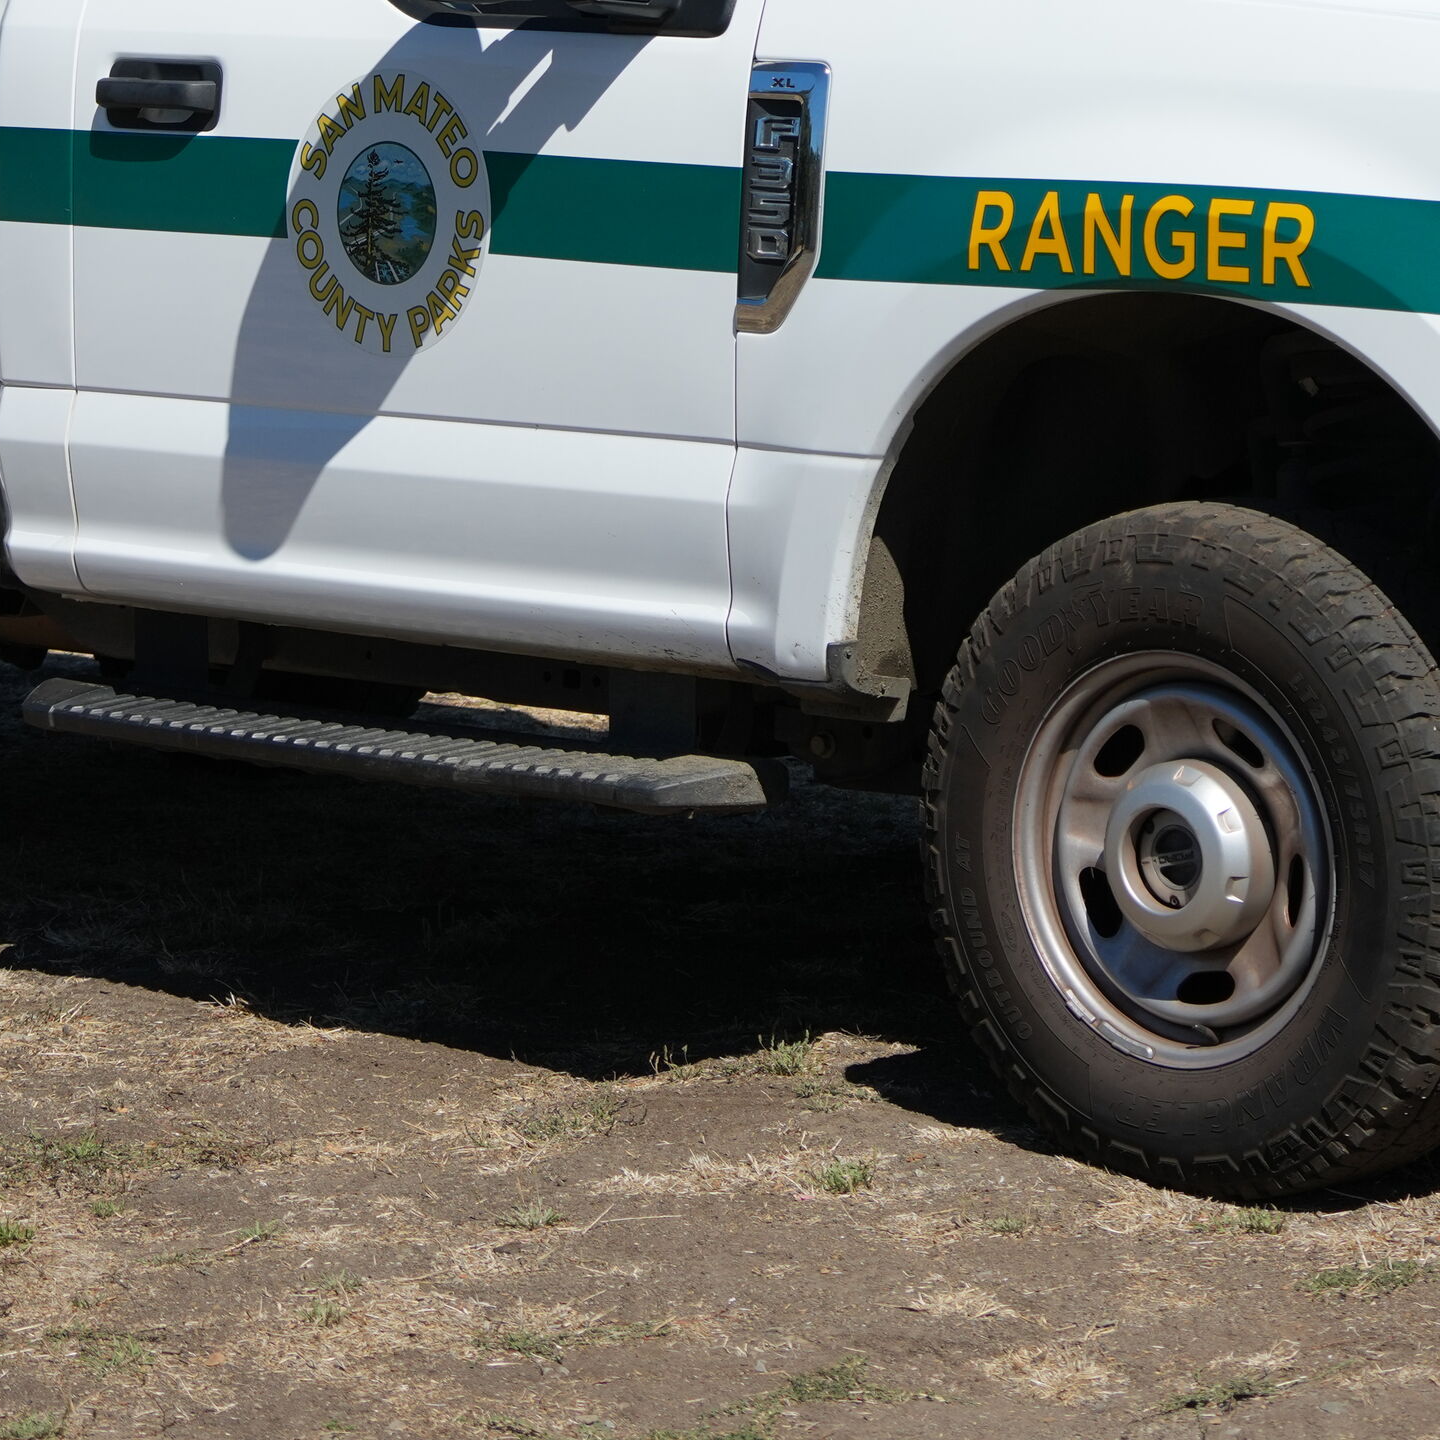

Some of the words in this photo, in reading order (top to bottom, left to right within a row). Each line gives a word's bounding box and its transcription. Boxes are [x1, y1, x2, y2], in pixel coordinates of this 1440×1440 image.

[300, 82, 367, 180] SAN
[373, 74, 479, 188] MATEO
[771, 77, 796, 89] XL
[291, 198, 398, 353] COUNTY
[406, 209, 485, 348] PARKS
[967, 190, 1316, 288] RANGER
[981, 581, 1205, 725] GOODYEAR
[955, 831, 972, 872] AT
[961, 887, 1033, 1040] OUTBOUND
[1110, 1004, 1349, 1136] WRANGLER
